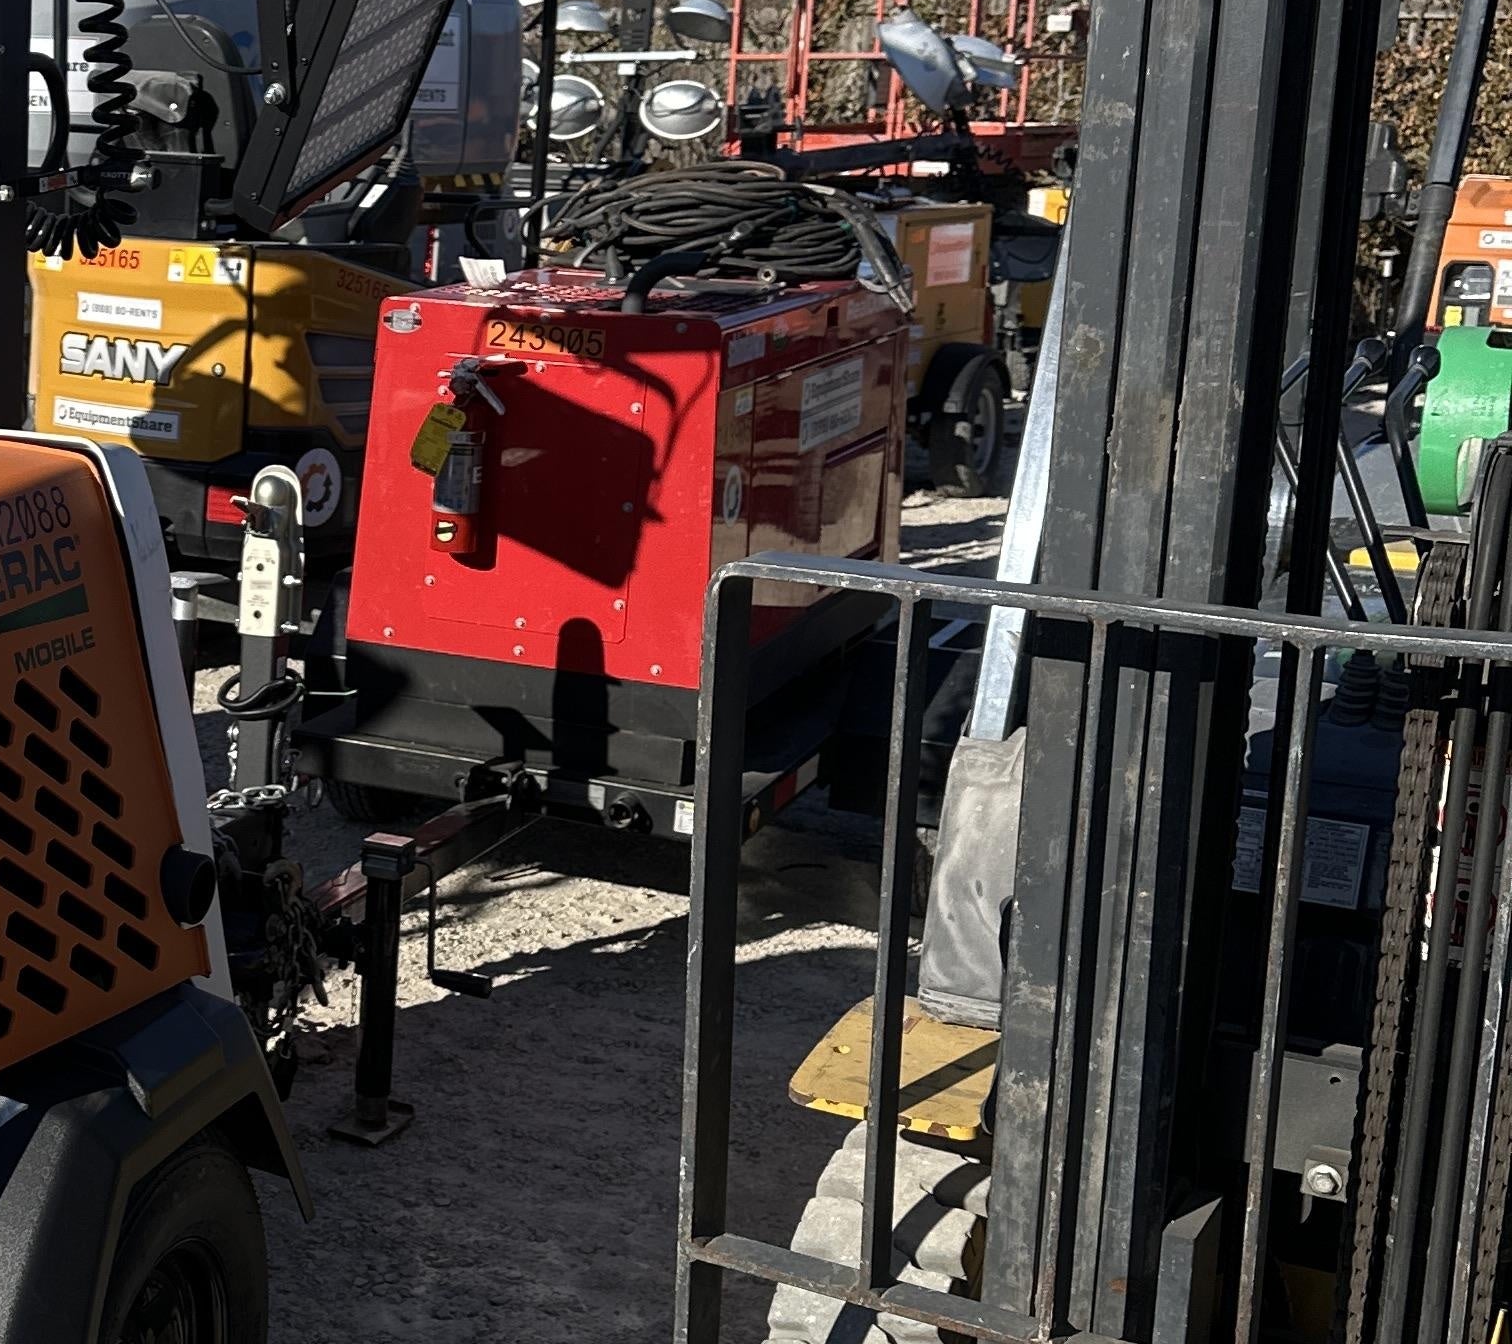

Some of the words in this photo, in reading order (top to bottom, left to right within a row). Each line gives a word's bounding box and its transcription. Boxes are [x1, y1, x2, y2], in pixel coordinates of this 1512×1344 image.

[59, 331, 190, 386] SANY
[489, 321, 603, 356] 243905
[68, 407, 174, 434] EquipmentShare
[14, 626, 97, 674] MOBILE
